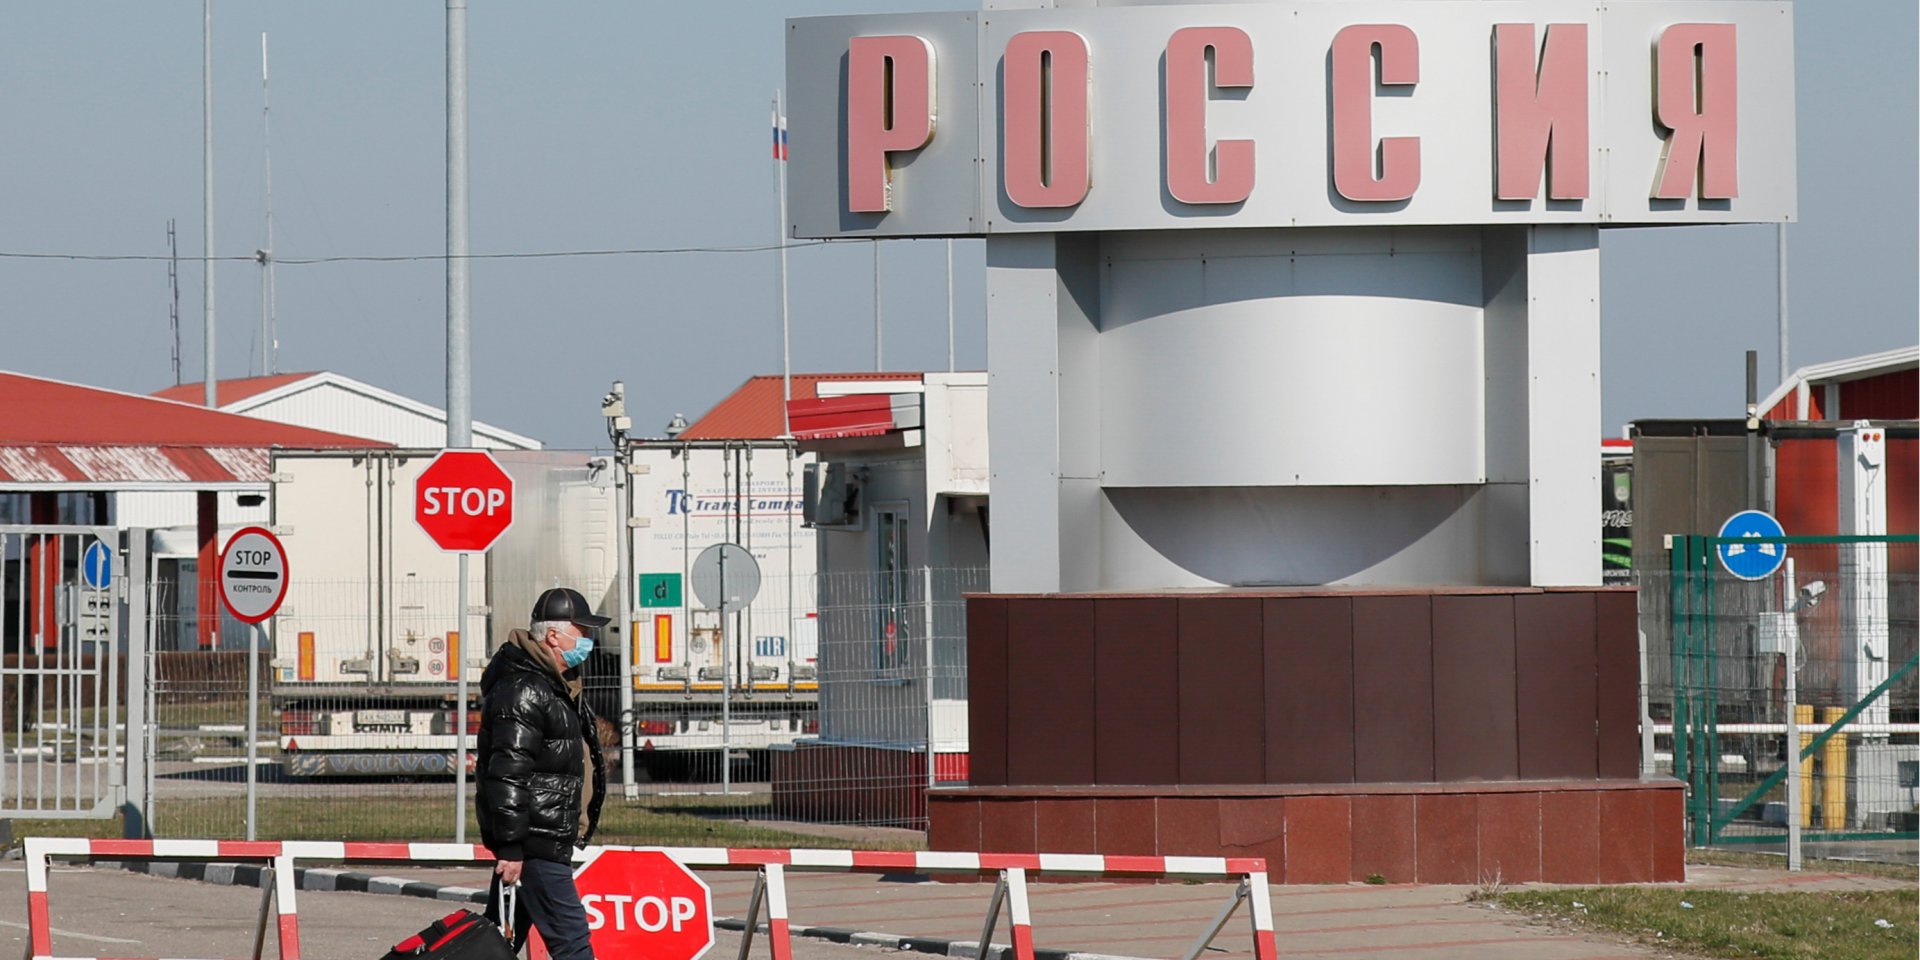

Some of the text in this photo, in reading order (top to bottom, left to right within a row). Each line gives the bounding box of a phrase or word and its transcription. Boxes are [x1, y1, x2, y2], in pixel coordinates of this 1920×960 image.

[848, 22, 1738, 213] РОССИЯ
[424, 486, 506, 516] STOP
[665, 488, 693, 515] TC
[696, 499, 740, 512] Trans
[235, 550, 272, 566] STOP
[233, 584, 273, 594] КОНТРОЛЬ
[654, 580, 667, 600] d
[757, 637, 782, 655] TIR
[353, 723, 413, 734] SCHMITZ
[327, 754, 446, 773] VOLVO
[581, 894, 697, 933] STOP
